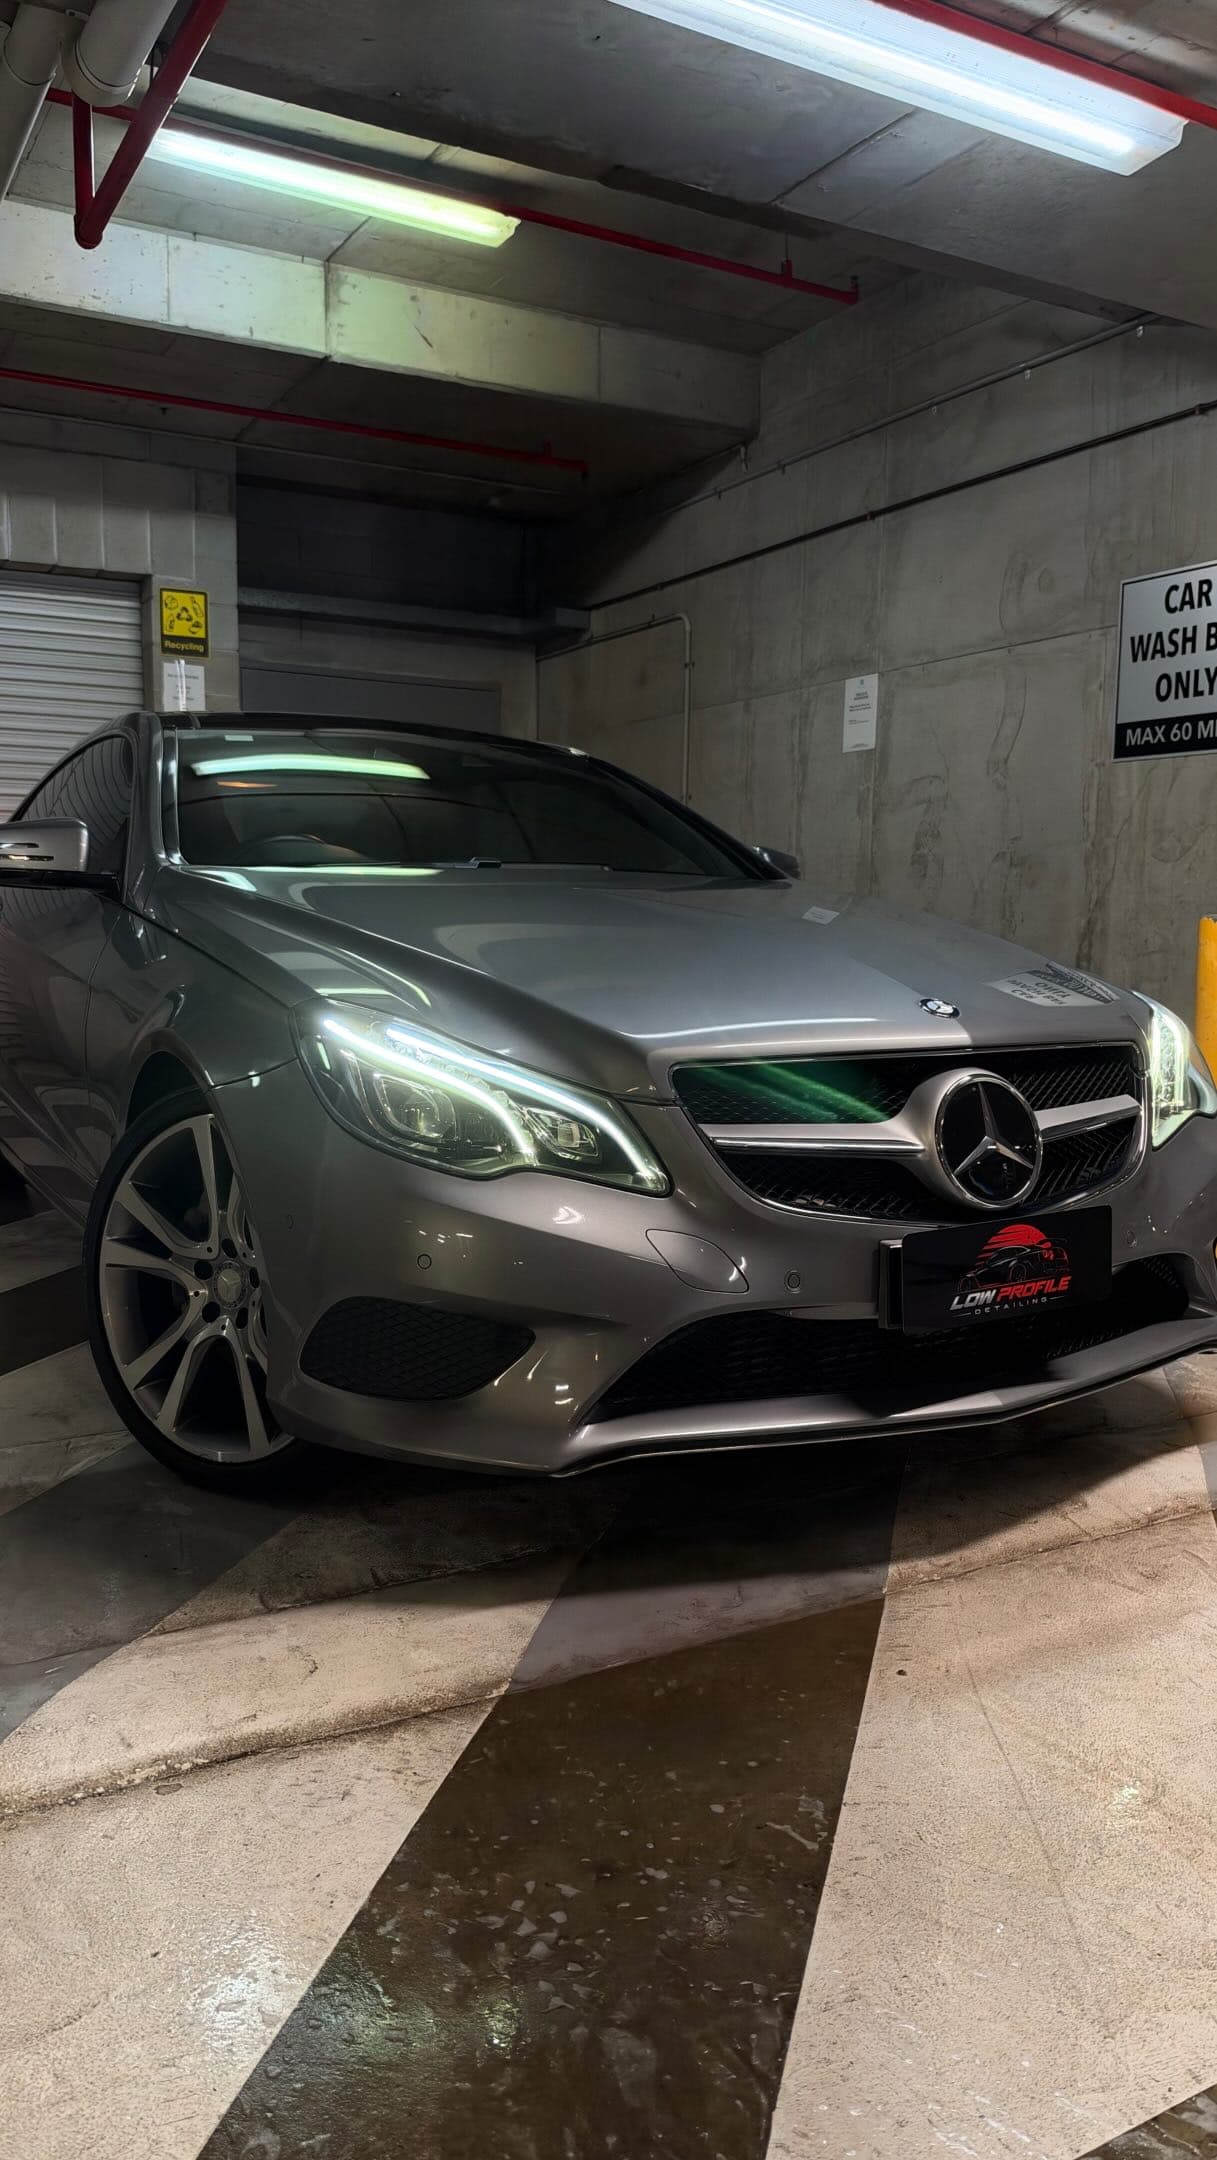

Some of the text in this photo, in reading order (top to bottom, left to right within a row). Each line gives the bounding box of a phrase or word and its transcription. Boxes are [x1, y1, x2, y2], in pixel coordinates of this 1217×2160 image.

[1164, 578, 1213, 614] CAR
[164, 641, 204, 653] Recycling
[1130, 625, 1198, 664] WASH
[1155, 666, 1217, 703] ONLY
[1126, 724, 1166, 747] MAX
[1170, 722, 1193, 742] 60
[950, 1275, 1072, 1311] LOW PROFILE
[974, 1296, 1048, 1315] DETAILING
